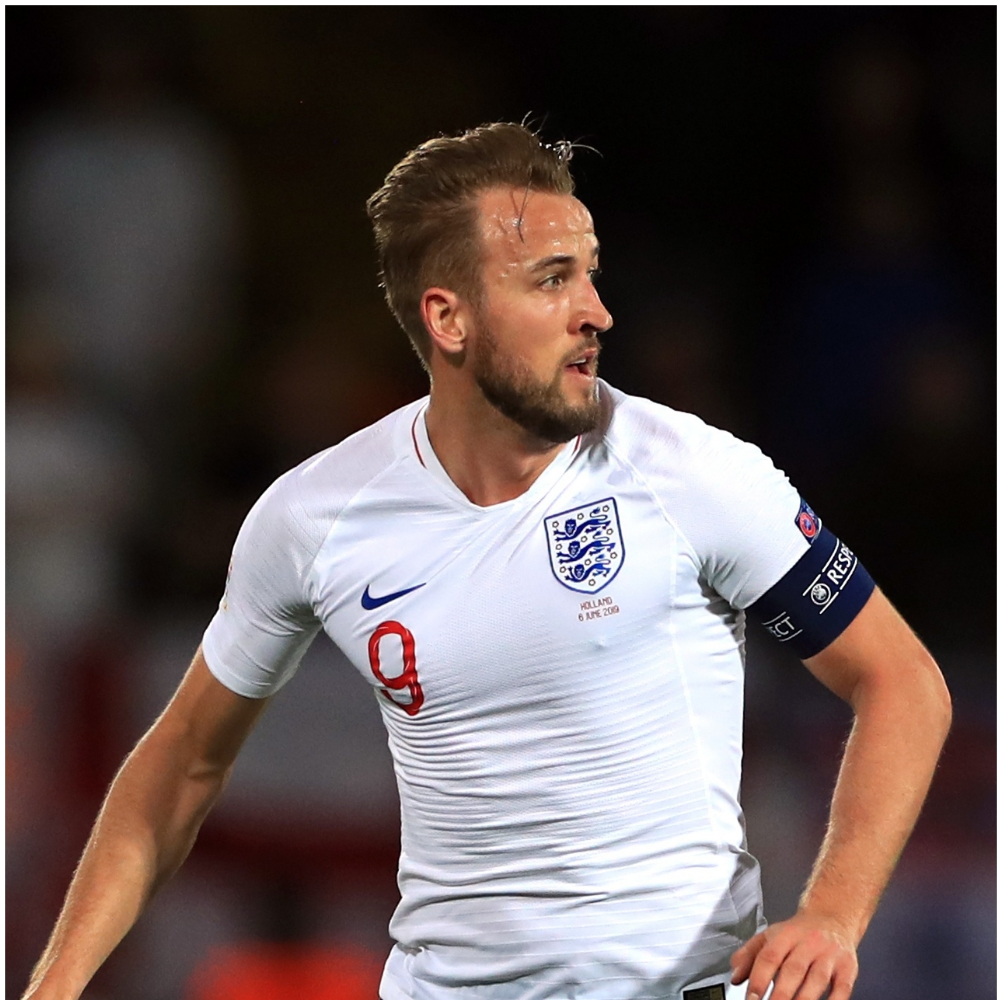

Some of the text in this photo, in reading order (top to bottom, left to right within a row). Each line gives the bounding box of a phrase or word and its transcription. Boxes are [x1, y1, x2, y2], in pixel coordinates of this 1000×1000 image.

[580, 596, 613, 611] HOLLAND
[578, 613, 584, 622] 6
[586, 609, 602, 621] JUNE
[368, 620, 425, 716] 9
